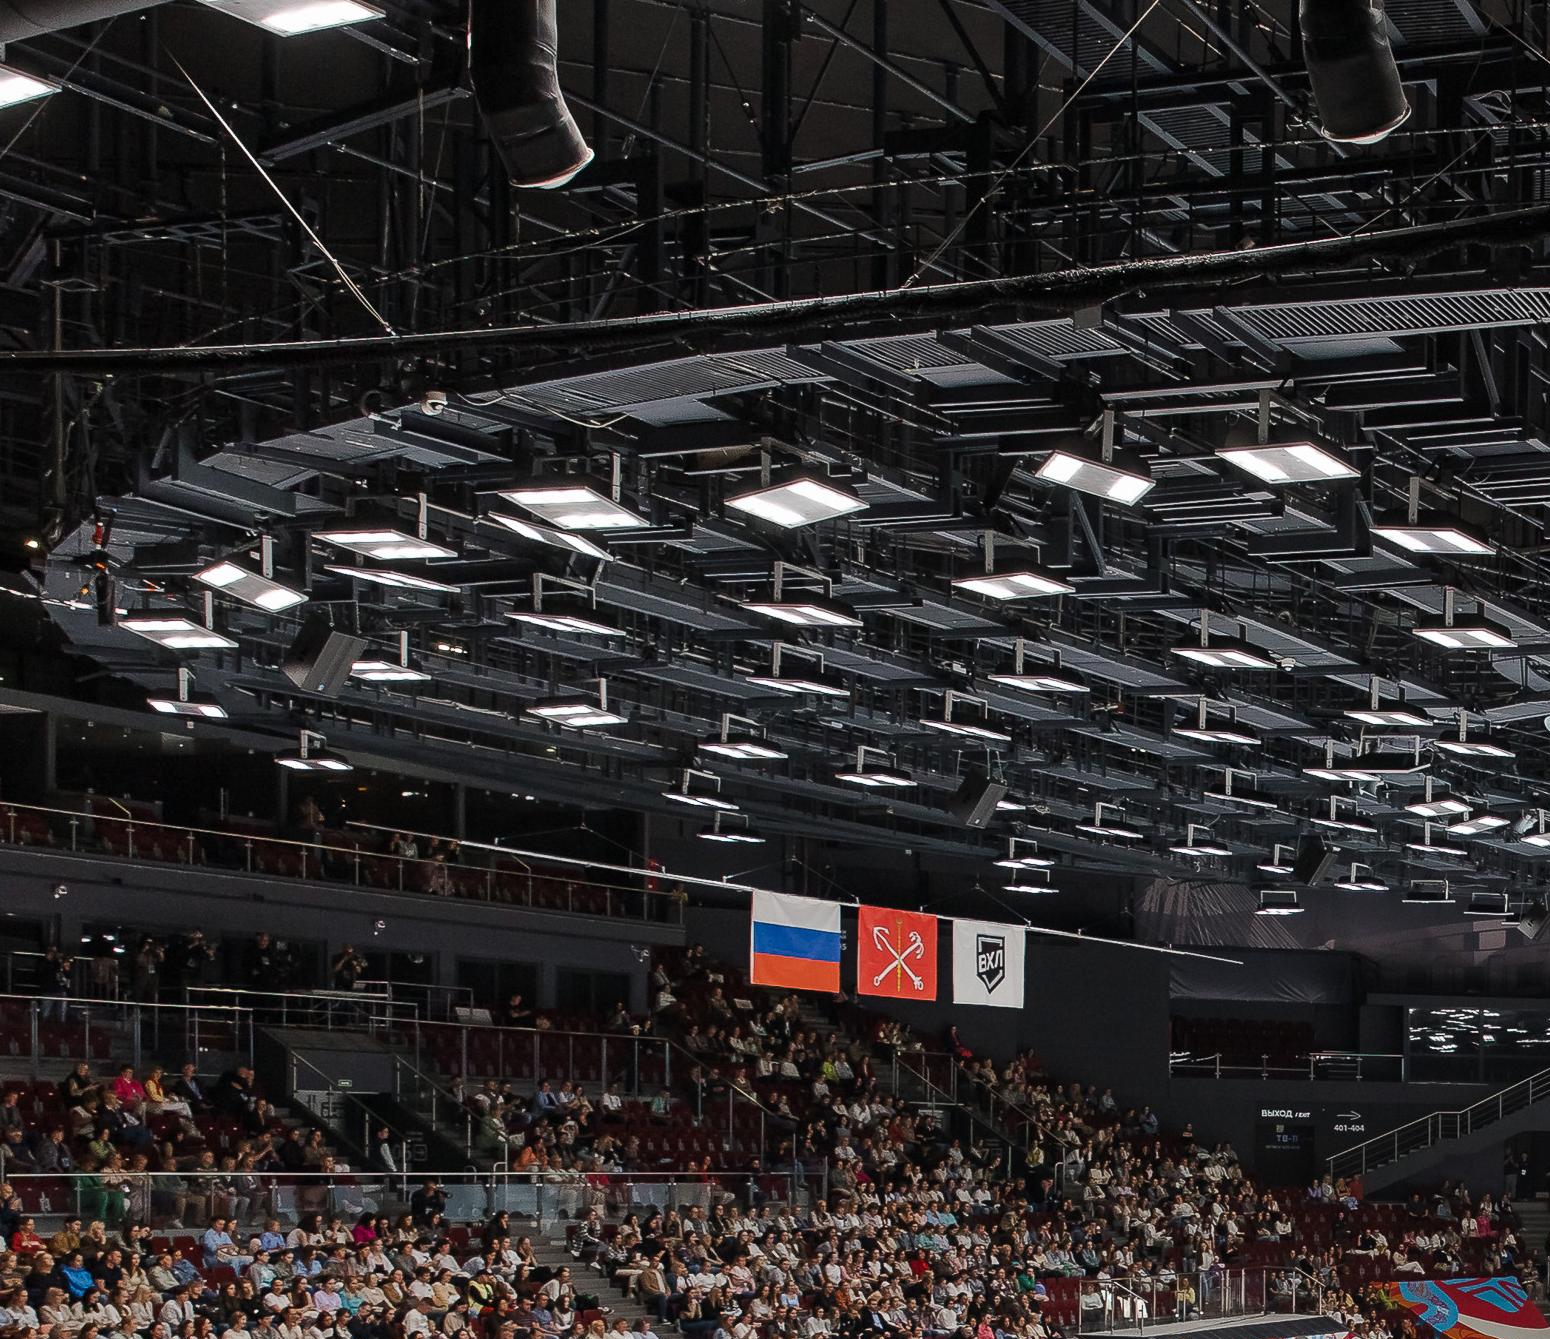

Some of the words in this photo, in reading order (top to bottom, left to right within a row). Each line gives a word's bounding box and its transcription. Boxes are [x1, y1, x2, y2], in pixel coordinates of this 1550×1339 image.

[978, 950, 1003, 973] ВХЛ
[1261, 1109, 1293, 1118] ВЫХОД
[1333, 1124, 1365, 1132] 401-404
